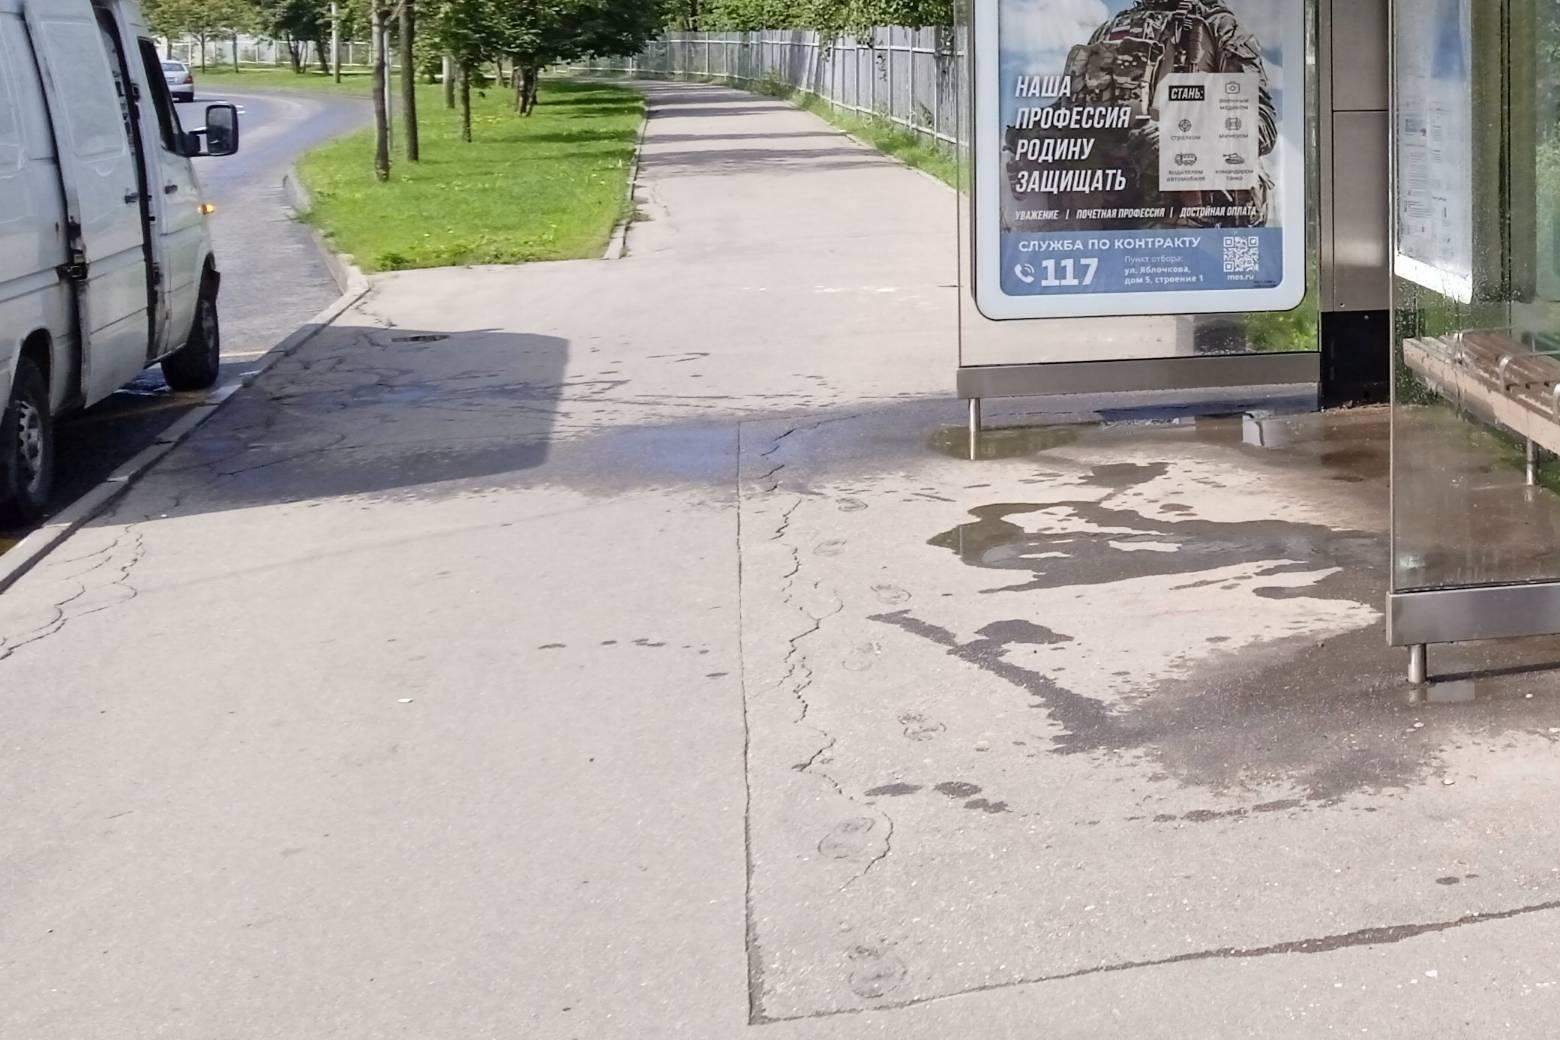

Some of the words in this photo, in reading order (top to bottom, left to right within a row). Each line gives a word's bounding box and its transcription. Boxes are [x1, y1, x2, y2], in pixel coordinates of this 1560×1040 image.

[1015, 75, 1071, 98] НАША
[1171, 87, 1204, 100] СТАНЬ:
[1015, 106, 1132, 129] ПРОФЕССИЯ
[1015, 138, 1095, 162] РОДИНУ
[1015, 169, 1127, 193] ЗАЩИЩАТЬ
[1015, 209, 1060, 220] УВАЖЕНИЕ
[1076, 208, 1117, 219] ПОЧЕТНАЯ
[1118, 207, 1165, 218] ПРОФЕССИЯ
[1179, 206, 1226, 218] ДОСТОЙНАЯ
[1226, 206, 1257, 216] ОПЛАТА
[1019, 240, 1084, 252] СЛУЖБА
[1088, 239, 1110, 250] ПО
[1114, 237, 1201, 250] КОНТРАКТУ
[1041, 258, 1099, 287] 117
[1124, 278, 1143, 286] дом
[1154, 276, 1197, 285] строение
